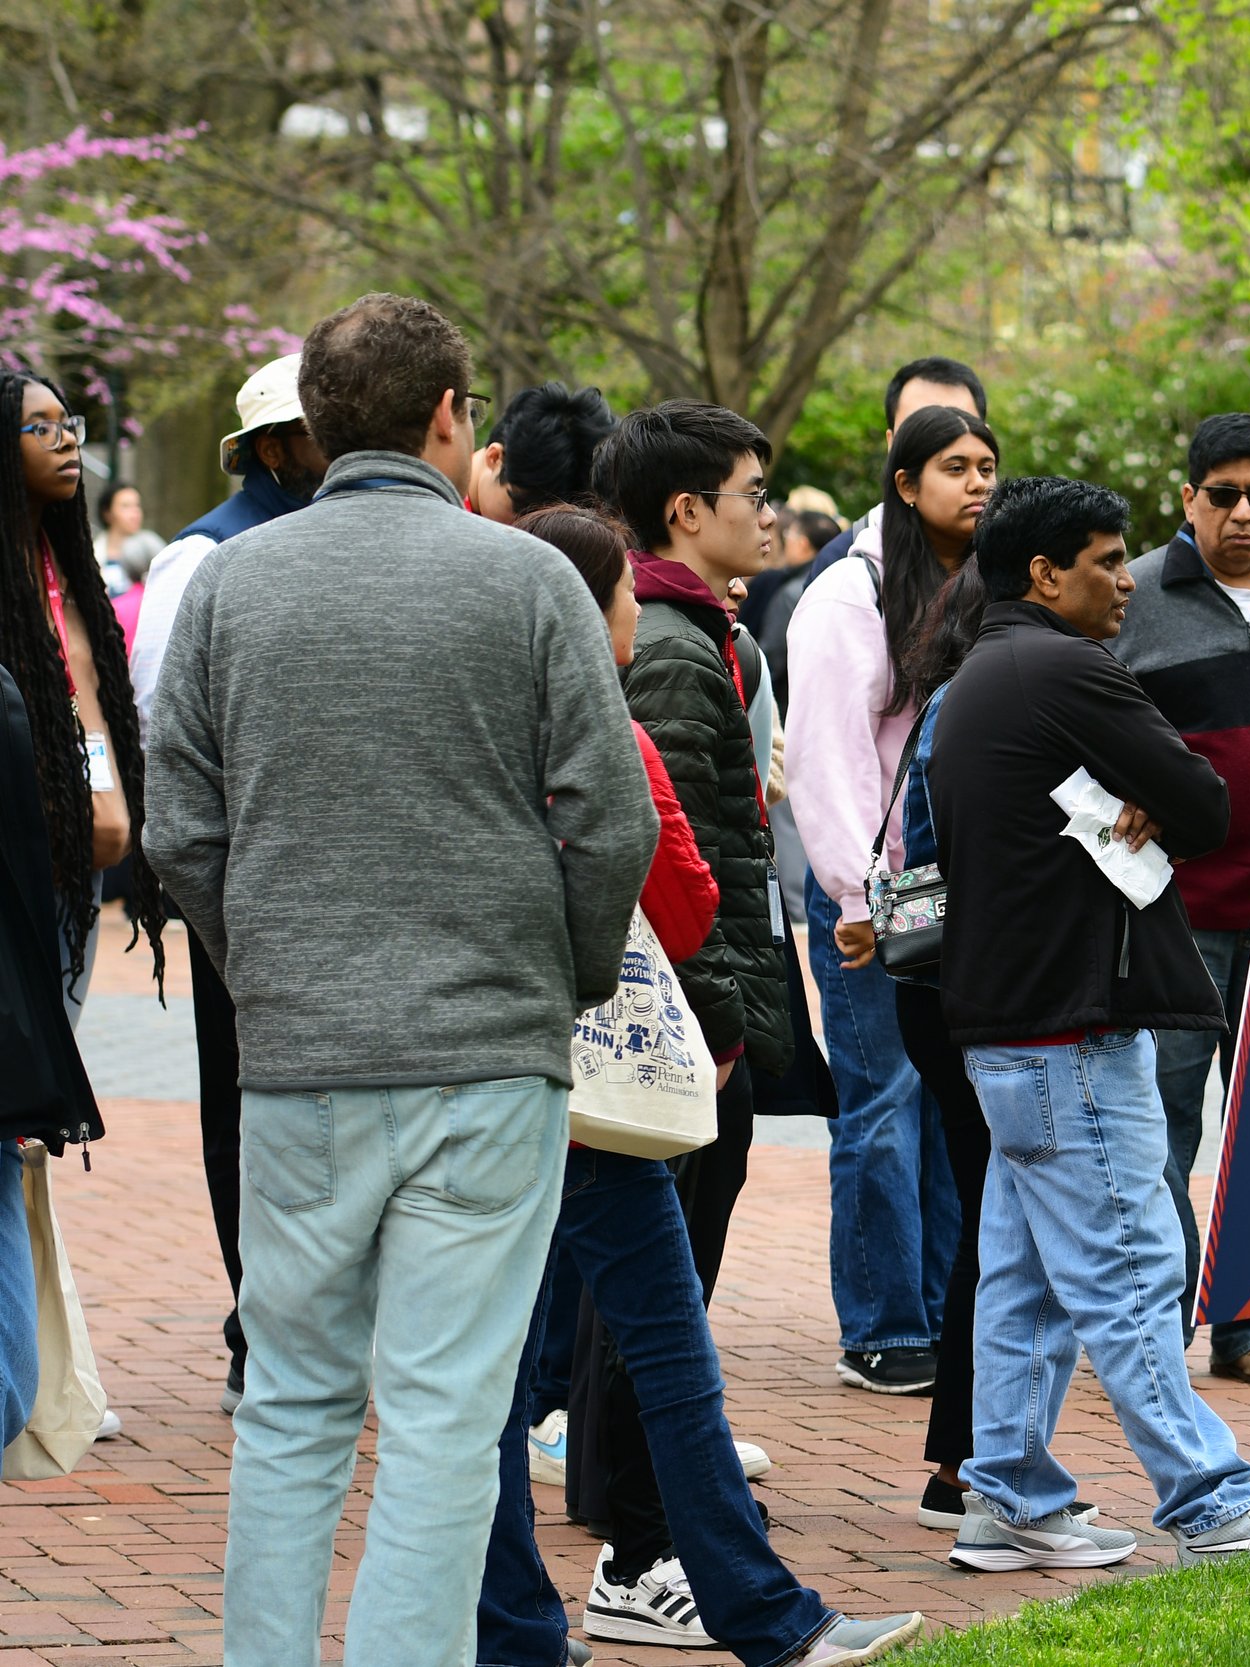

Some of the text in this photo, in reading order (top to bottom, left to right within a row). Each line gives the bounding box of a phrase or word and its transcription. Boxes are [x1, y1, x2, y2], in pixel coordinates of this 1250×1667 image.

[573, 1022, 614, 1049] PENN
[657, 1066, 683, 1084] Penn
[657, 1083, 699, 1097] Admissions
